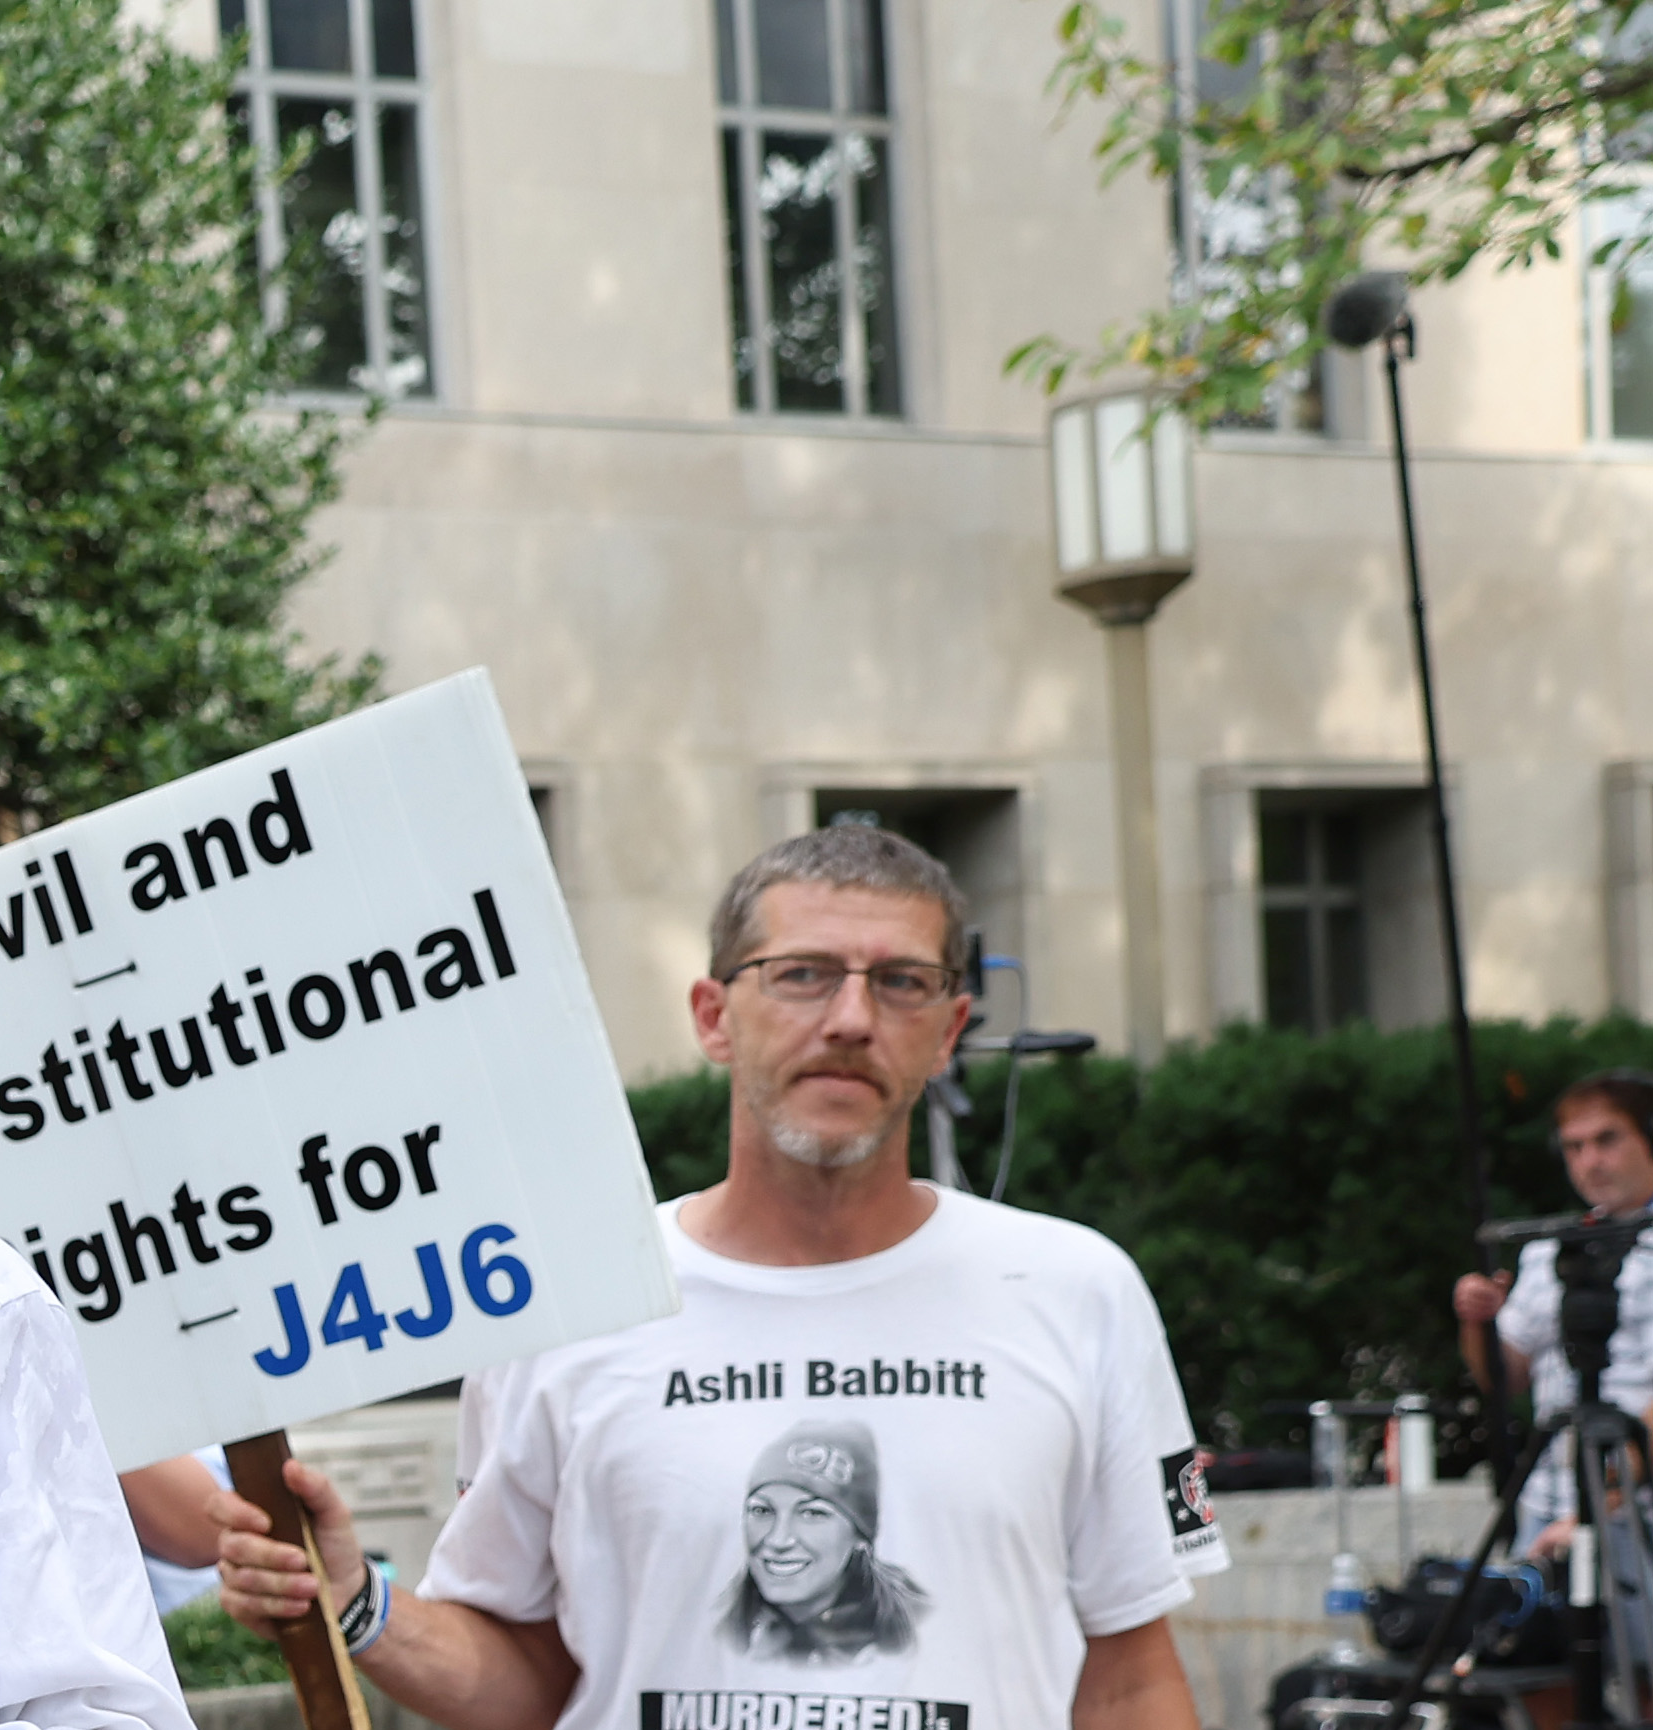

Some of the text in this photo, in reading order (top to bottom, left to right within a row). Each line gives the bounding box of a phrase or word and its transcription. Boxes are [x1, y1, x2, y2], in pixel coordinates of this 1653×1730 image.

[122, 767, 314, 913] and
[10, 1123, 442, 1324] ights for
[252, 1222, 535, 1379] J4J6
[664, 1358, 986, 1408] Ashli Babbitt
